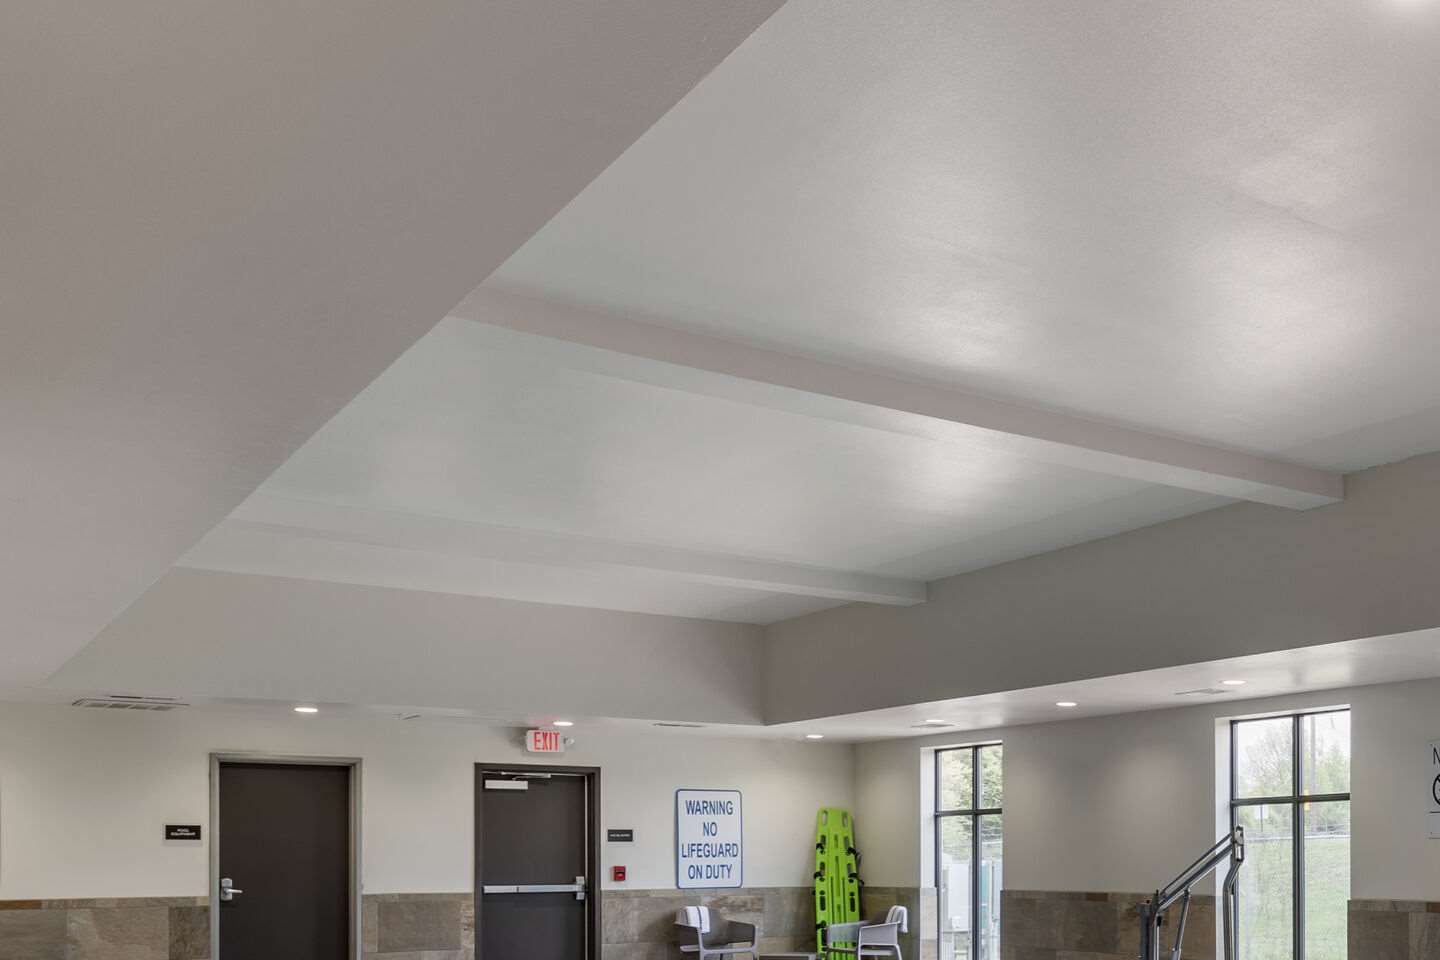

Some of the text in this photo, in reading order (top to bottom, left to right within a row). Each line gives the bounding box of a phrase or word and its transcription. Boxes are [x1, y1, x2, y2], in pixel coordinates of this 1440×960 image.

[534, 731, 560, 751] EXIT
[685, 799, 733, 815] WARNING
[703, 821, 718, 836] NO
[681, 843, 739, 858] LIFEGUARD
[688, 864, 732, 879] ON DUTY
